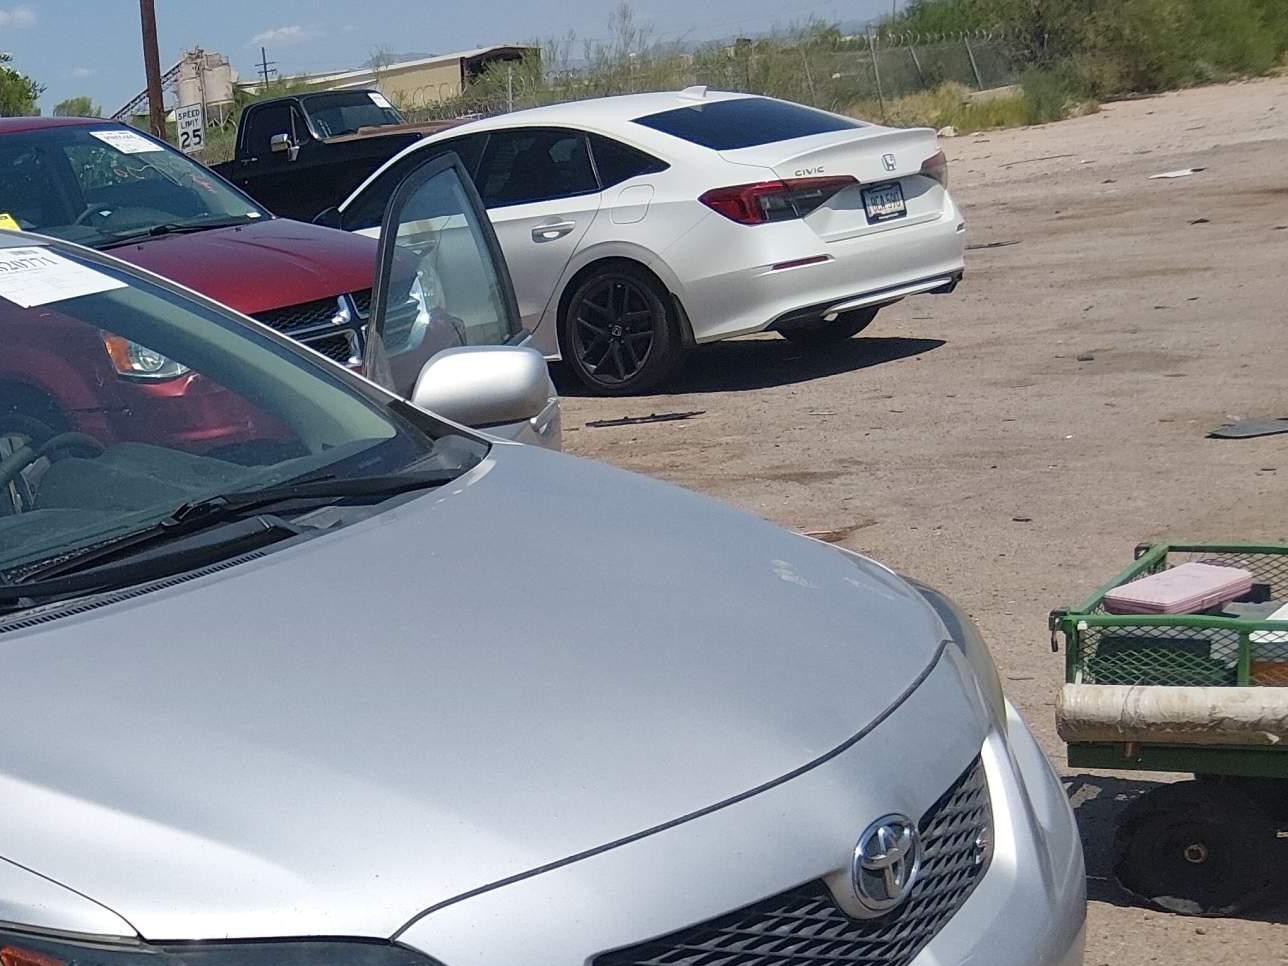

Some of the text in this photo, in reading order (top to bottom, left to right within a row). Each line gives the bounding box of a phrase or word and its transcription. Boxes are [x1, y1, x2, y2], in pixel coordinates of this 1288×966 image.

[178, 109, 200, 120] SPEED
[181, 118, 199, 129] LIMIT
[181, 128, 202, 149] 25
[795, 166, 825, 176] CIVIC
